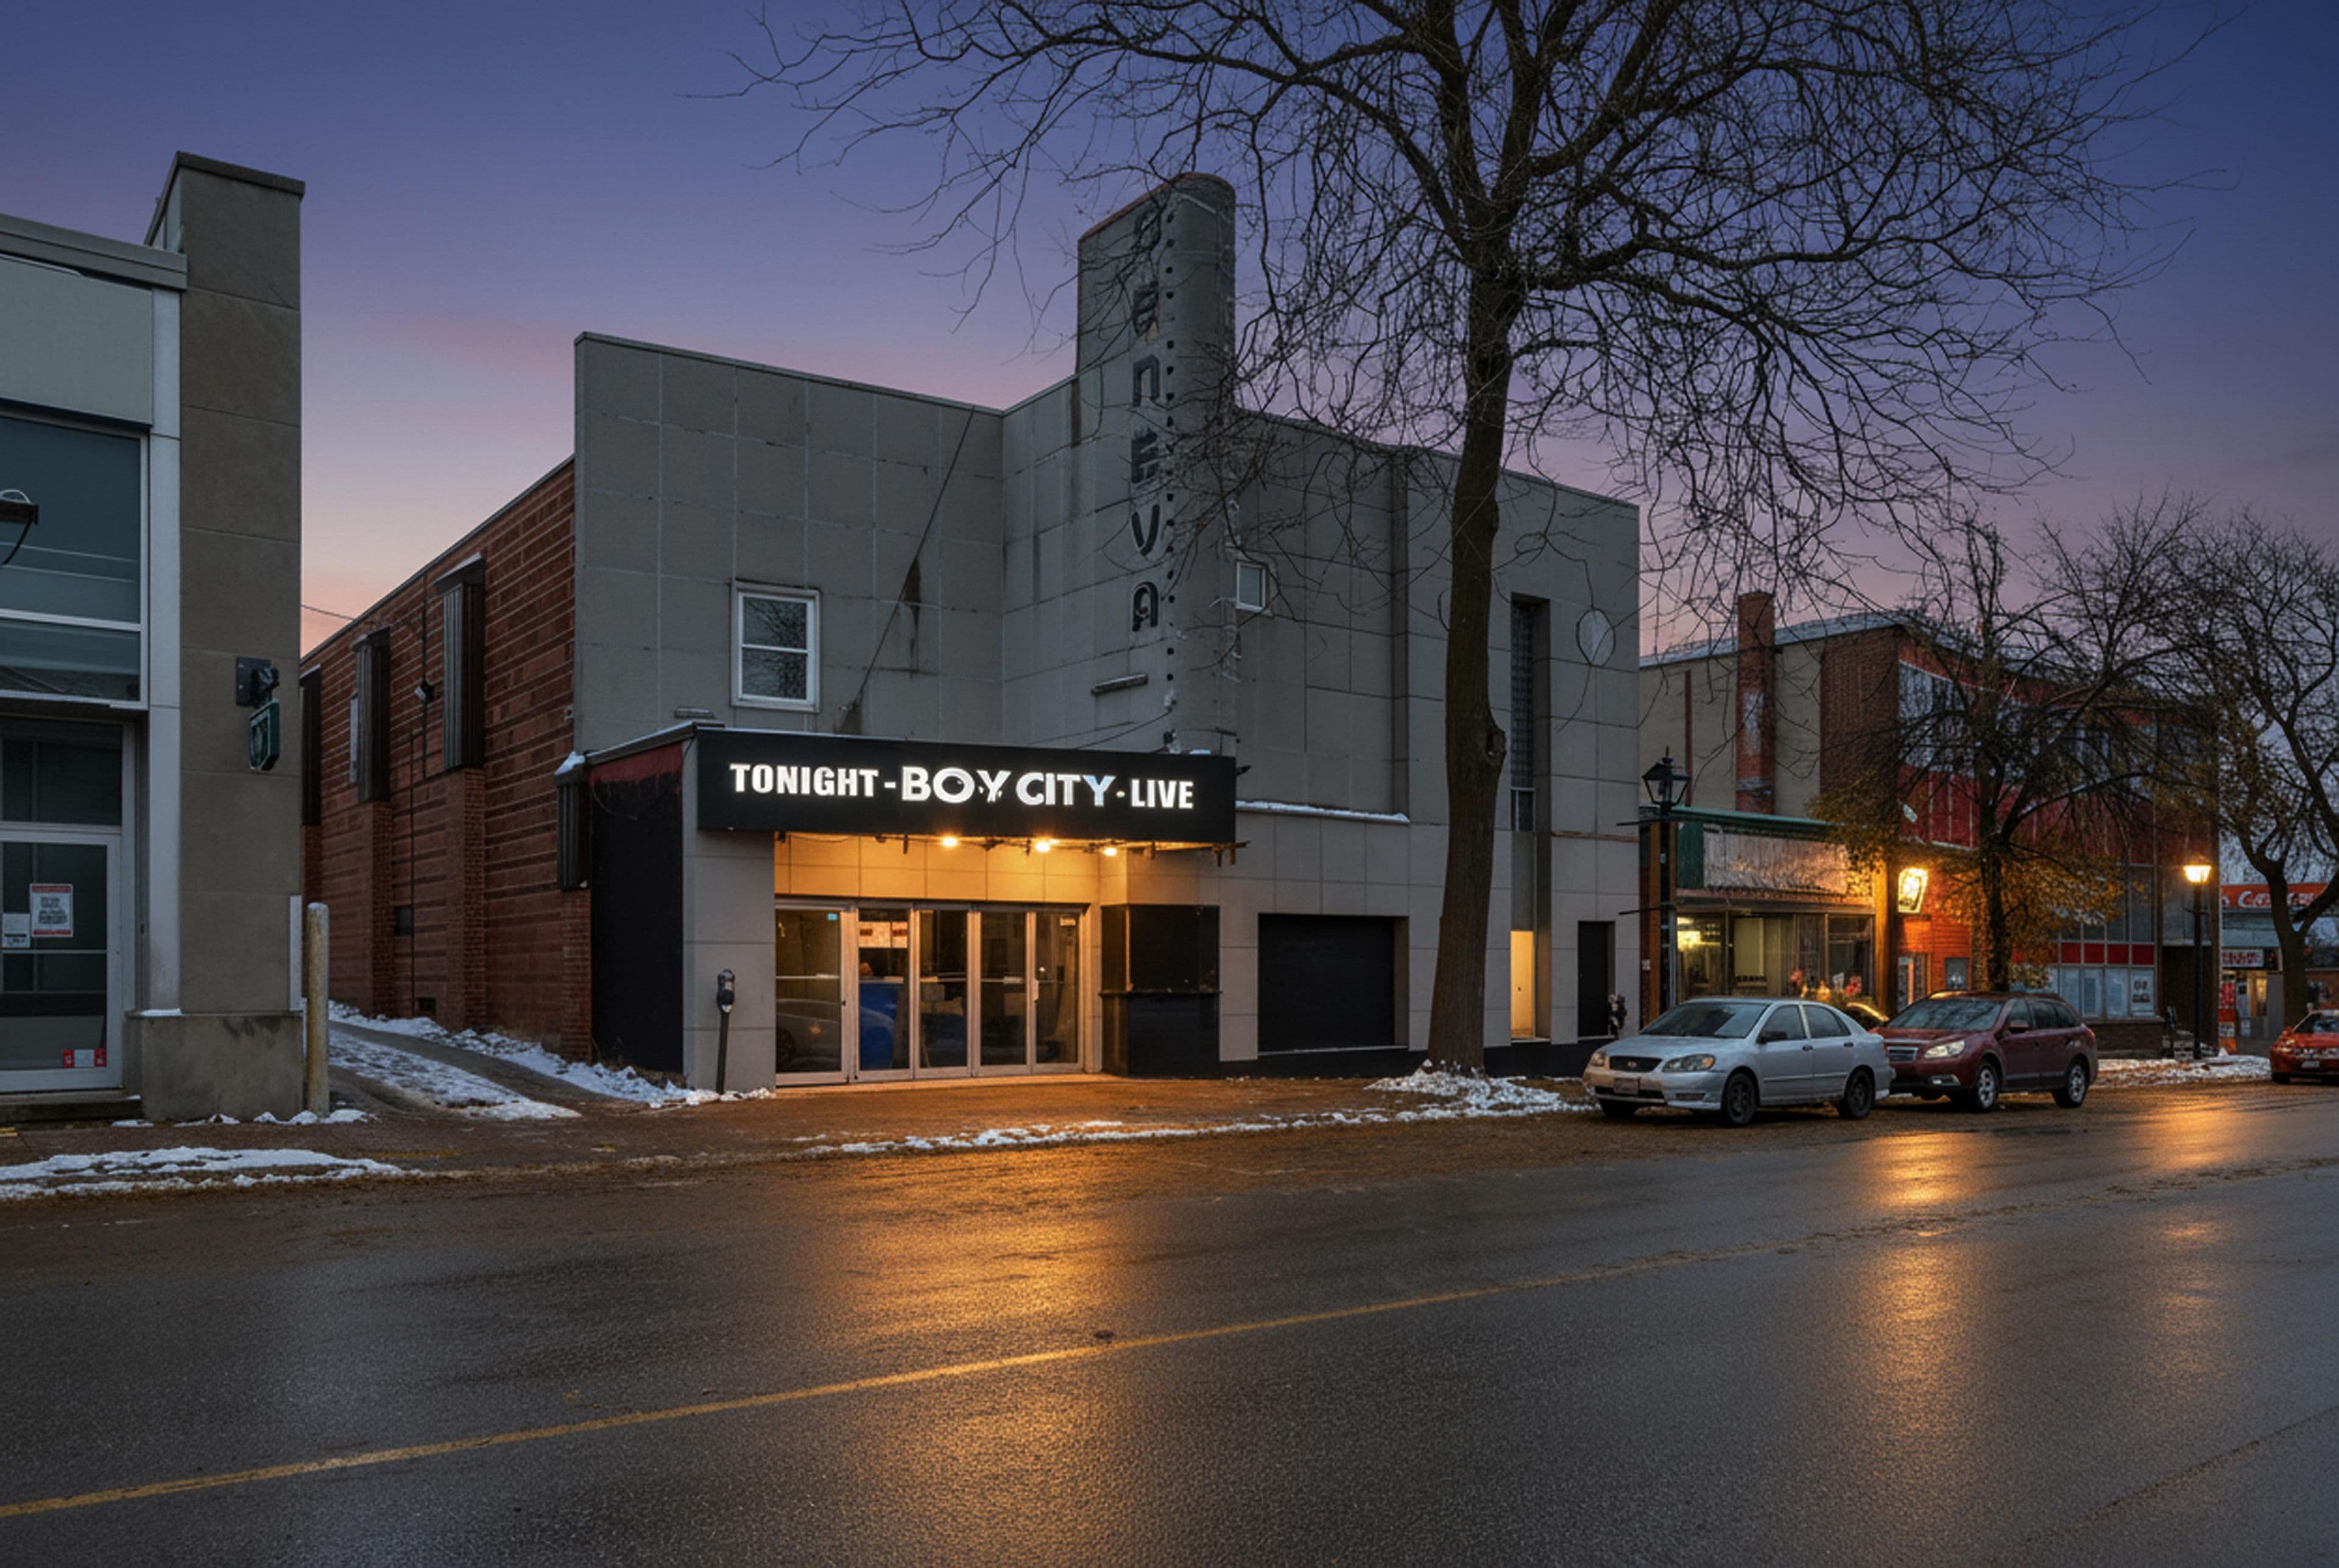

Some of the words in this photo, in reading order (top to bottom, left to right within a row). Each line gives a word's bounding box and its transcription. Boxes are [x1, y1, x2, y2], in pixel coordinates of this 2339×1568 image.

[730, 763, 879, 797] TONIGHT
[901, 766, 1011, 803] BOY
[1015, 772, 1116, 807] CITY
[1131, 779, 1193, 809] LIVE
